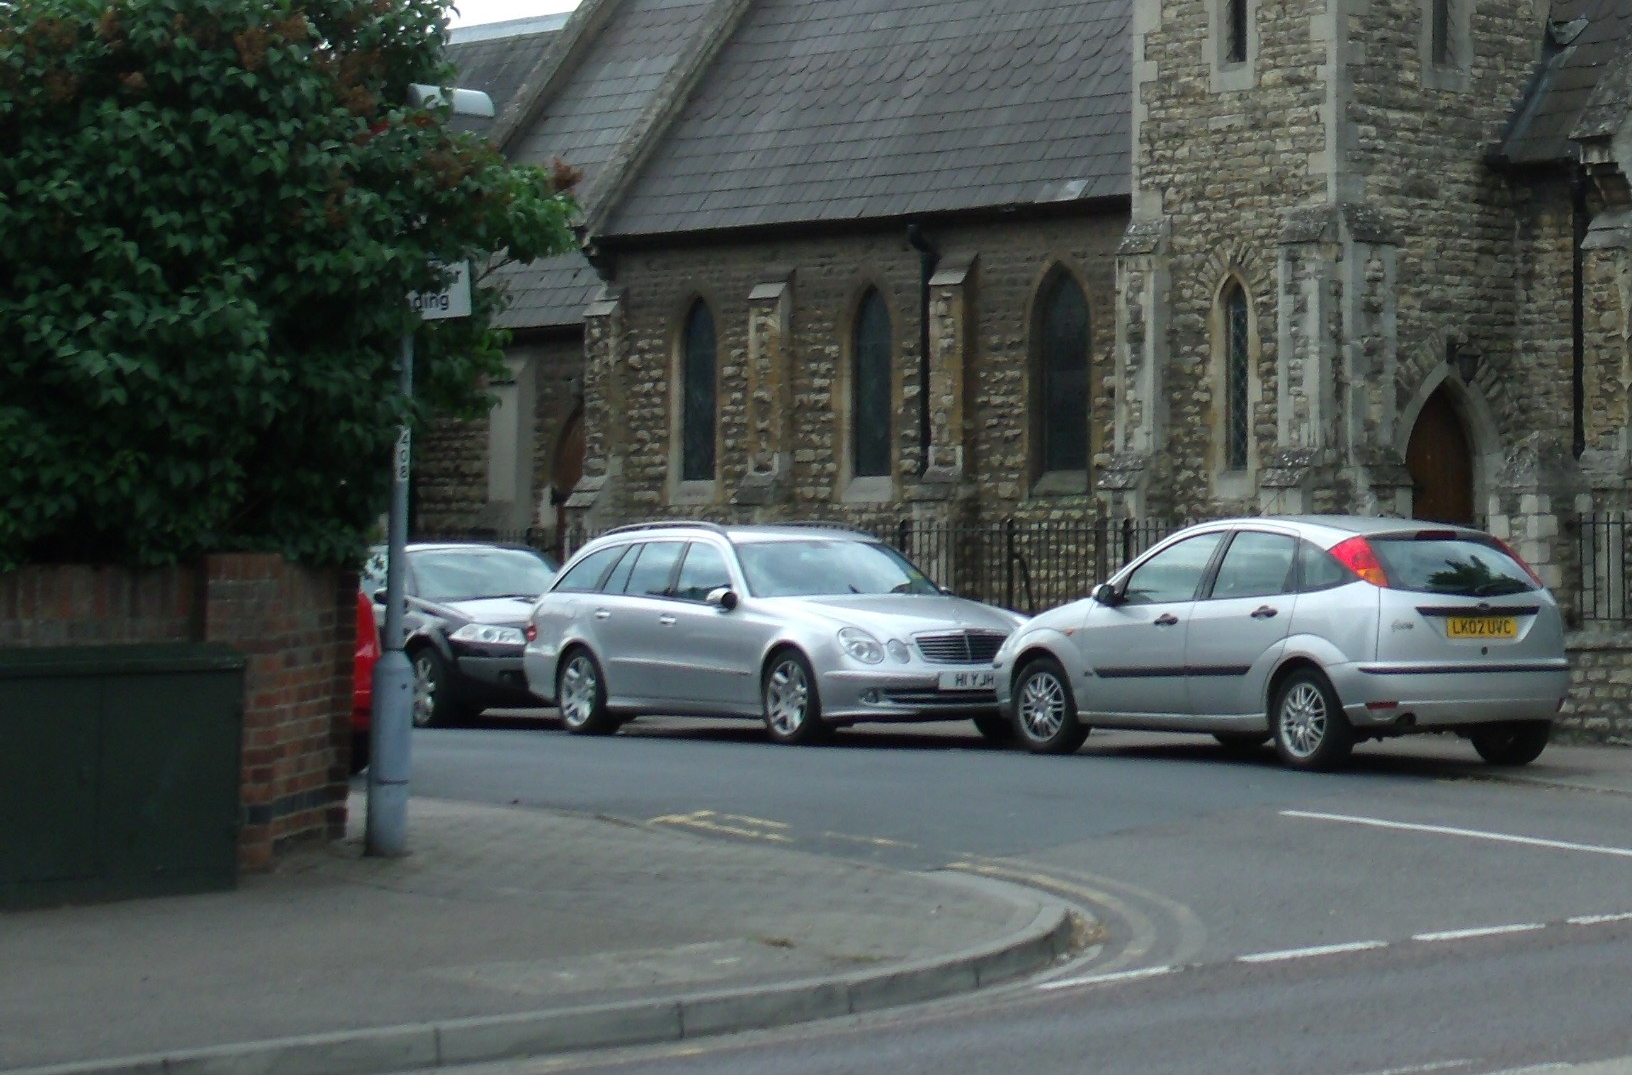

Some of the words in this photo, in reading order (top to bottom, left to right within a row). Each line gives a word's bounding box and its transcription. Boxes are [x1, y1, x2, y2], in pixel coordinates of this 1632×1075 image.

[1452, 621, 1486, 635] LK02
[1488, 621, 1512, 635] UVC
[971, 673, 994, 686] YJH
